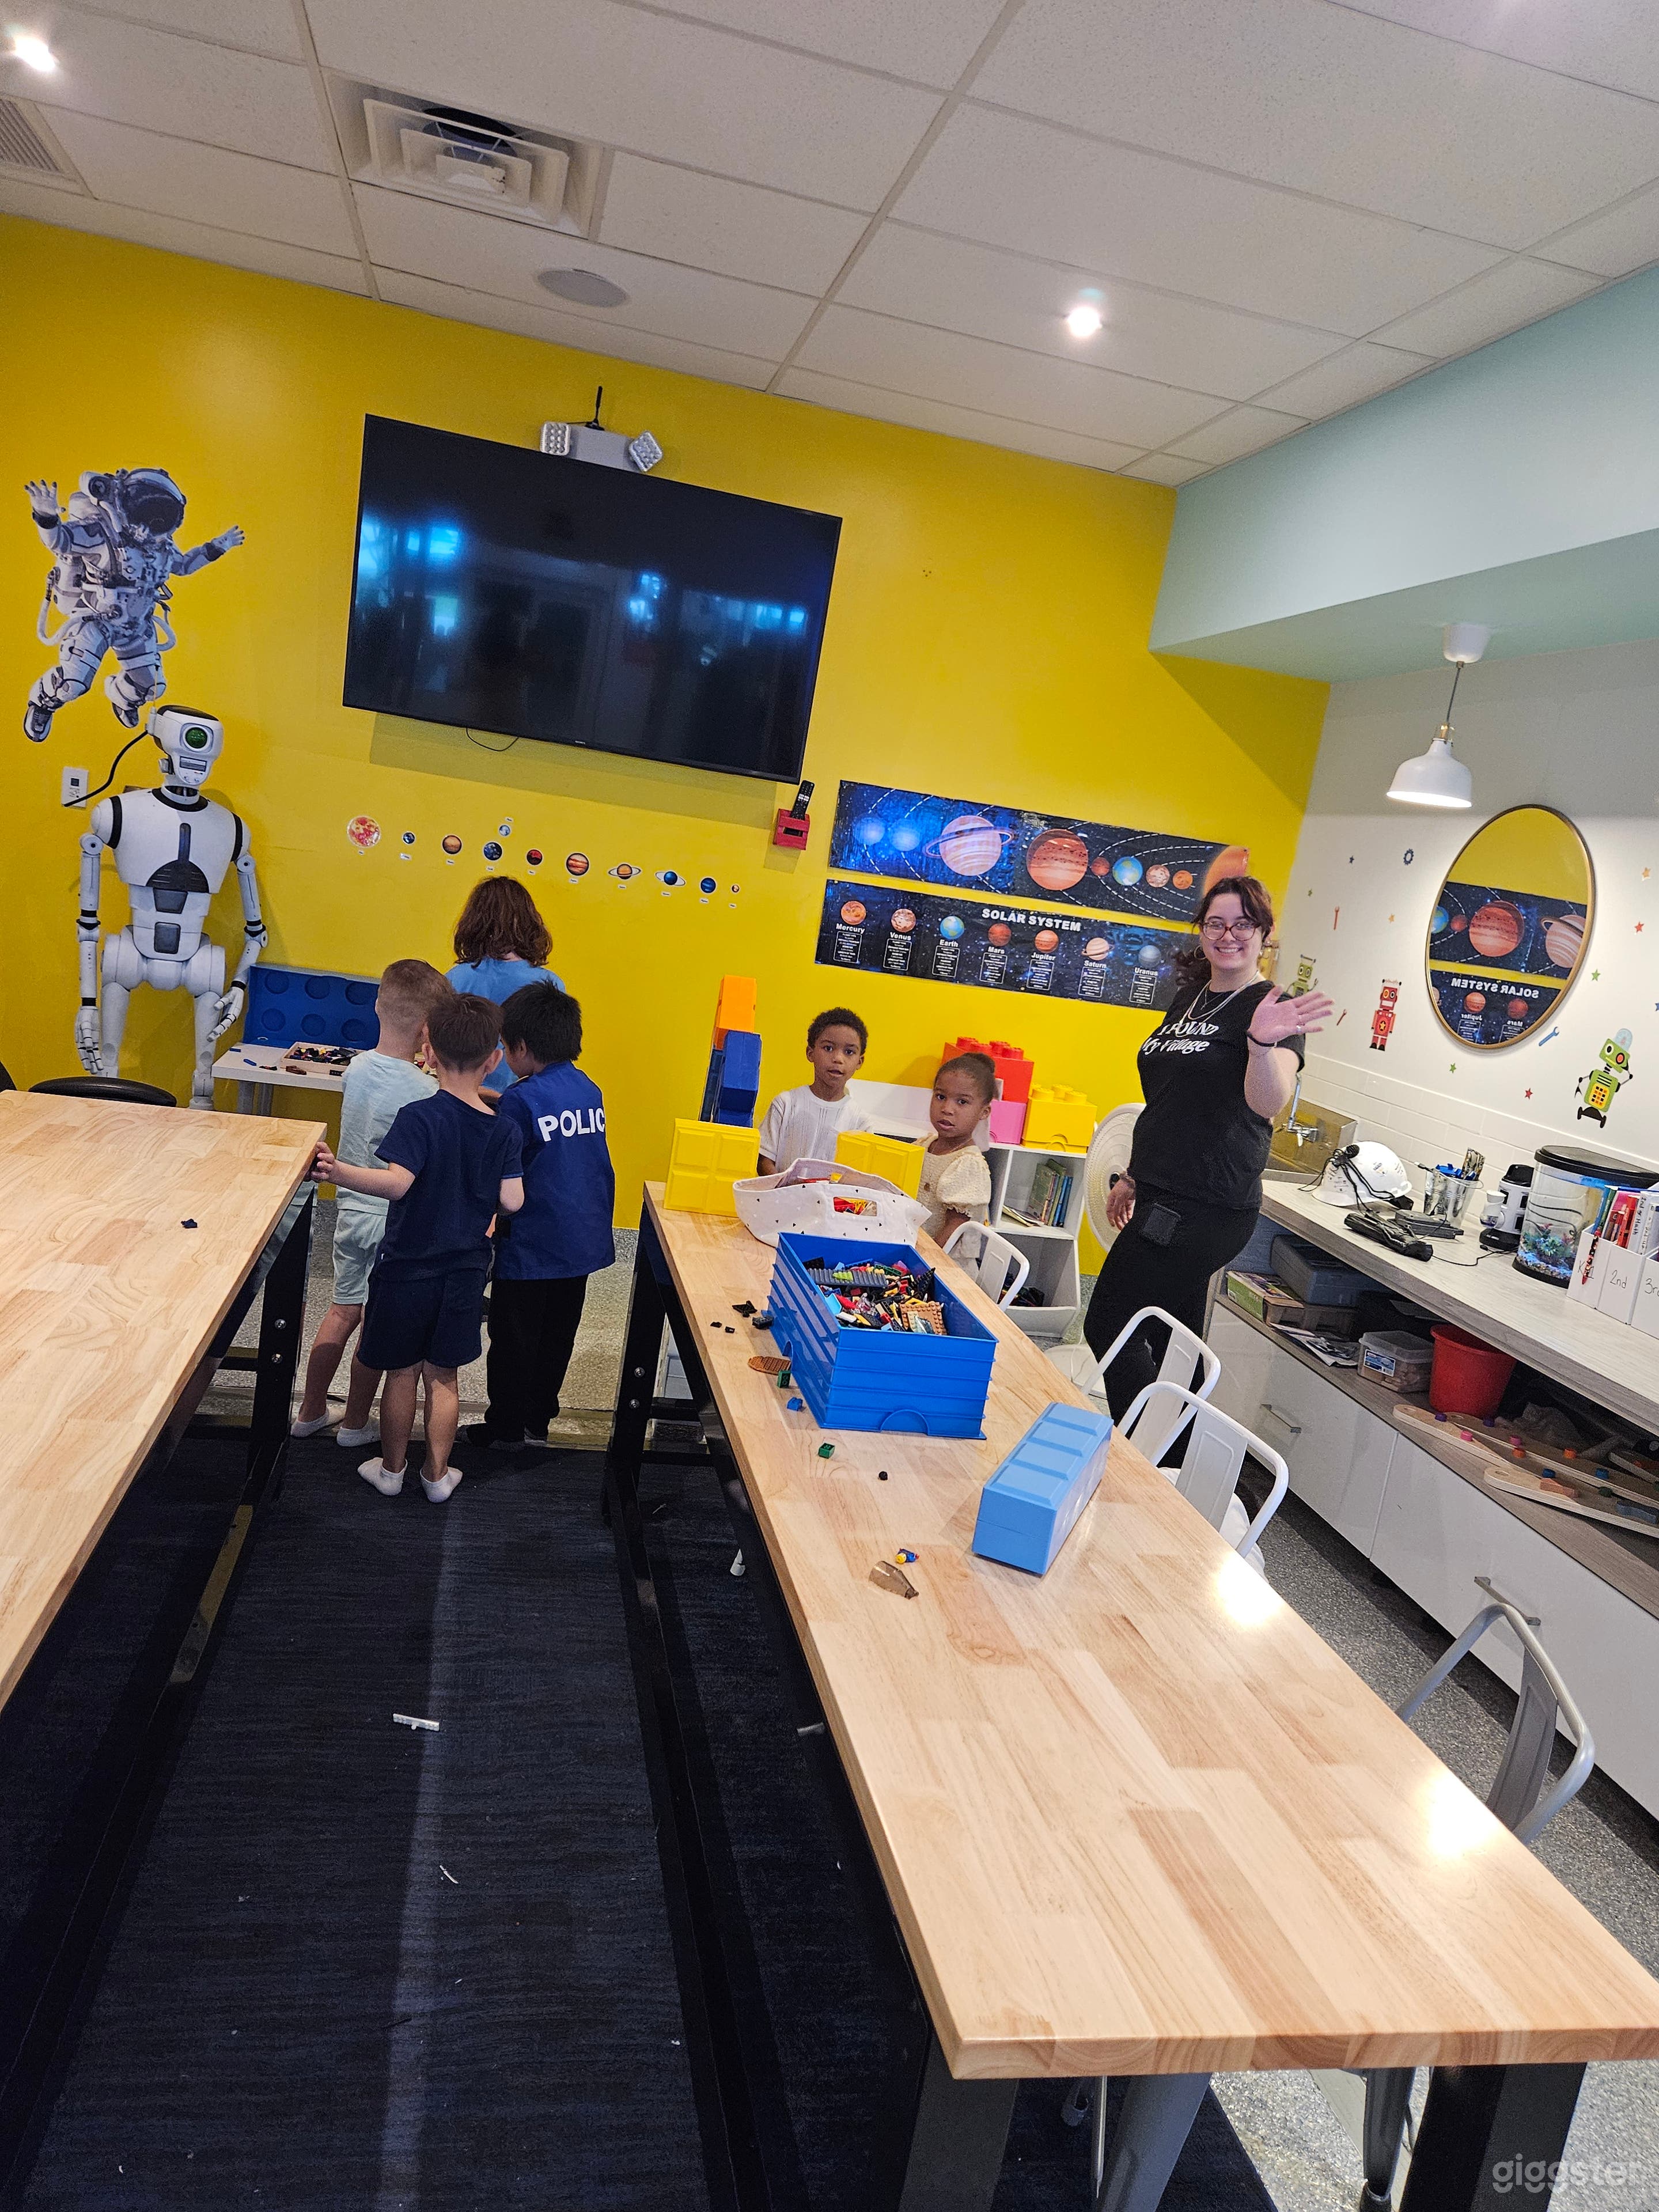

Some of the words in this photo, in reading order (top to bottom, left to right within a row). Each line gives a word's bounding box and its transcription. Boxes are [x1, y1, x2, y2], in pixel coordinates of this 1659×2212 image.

[982, 908, 1026, 924] SOLAR
[1028, 916, 1081, 932] SYSTEM
[836, 923, 865, 934] Mercury
[890, 932, 912, 941] Venus
[940, 940, 959, 948] Earth
[988, 946, 1005, 955] Mars
[1031, 952, 1056, 961] Jupiter
[1084, 960, 1107, 969] Saturn
[1134, 967, 1158, 976] Uranus
[1610, 1270, 1627, 1289] 2nd
